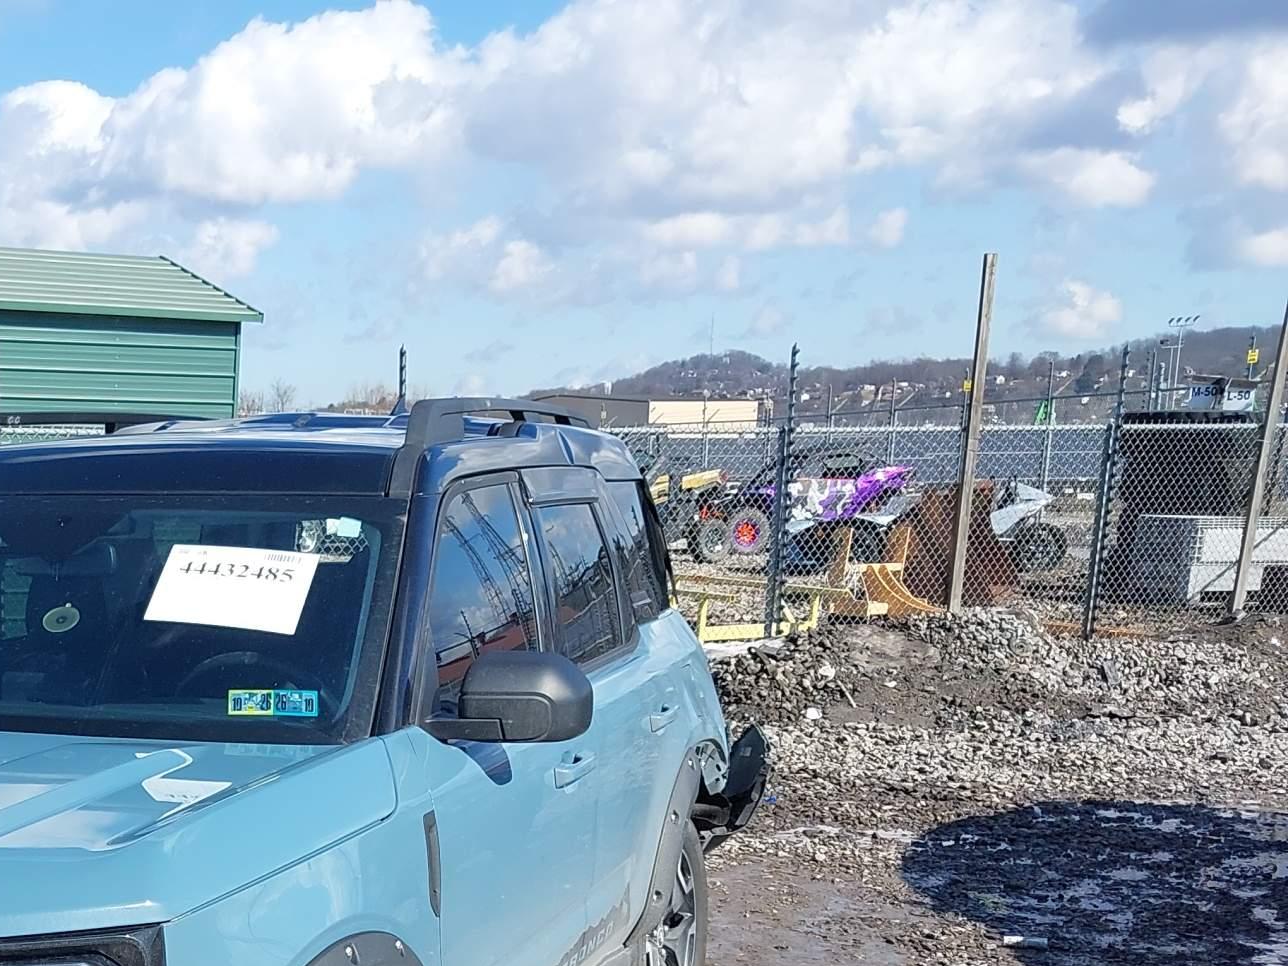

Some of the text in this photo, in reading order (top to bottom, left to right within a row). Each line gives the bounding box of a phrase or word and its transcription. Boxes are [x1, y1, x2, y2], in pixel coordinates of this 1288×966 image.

[1192, 386, 1218, 397] M-50
[1227, 390, 1251, 401] L-50
[179, 561, 295, 583] 44432485
